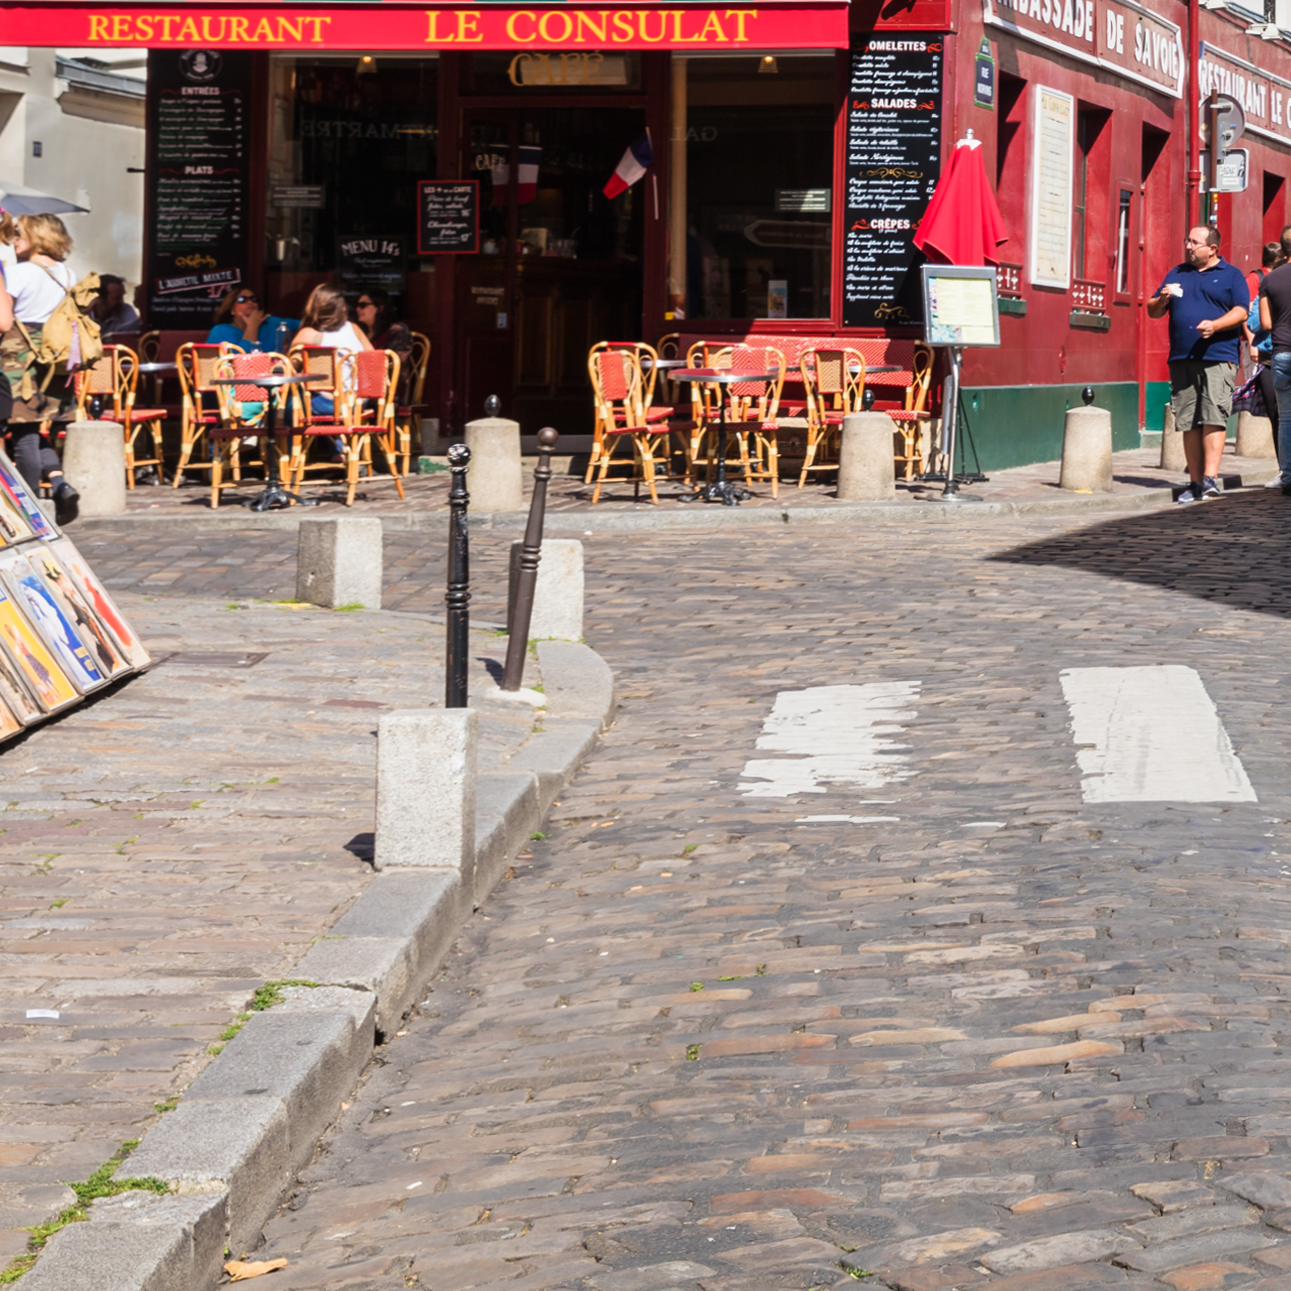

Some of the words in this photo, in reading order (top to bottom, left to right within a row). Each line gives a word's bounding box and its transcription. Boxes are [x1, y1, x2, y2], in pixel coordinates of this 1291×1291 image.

[87, 15, 331, 42] RESTAURANT
[425, 11, 483, 42] LE
[505, 9, 757, 42] CONSULAT
[869, 41, 926, 51] OMELETTES
[1106, 9, 1124, 54] DE
[1134, 22, 1178, 80] SAVOIE
[871, 98, 917, 109] SALADES
[1271, 90, 1283, 125] LE
[185, 166, 213, 175] PLATS
[870, 218, 911, 230] CRÊPES
[341, 239, 378, 256] MENU
[203, 271, 233, 283] MIXTE
